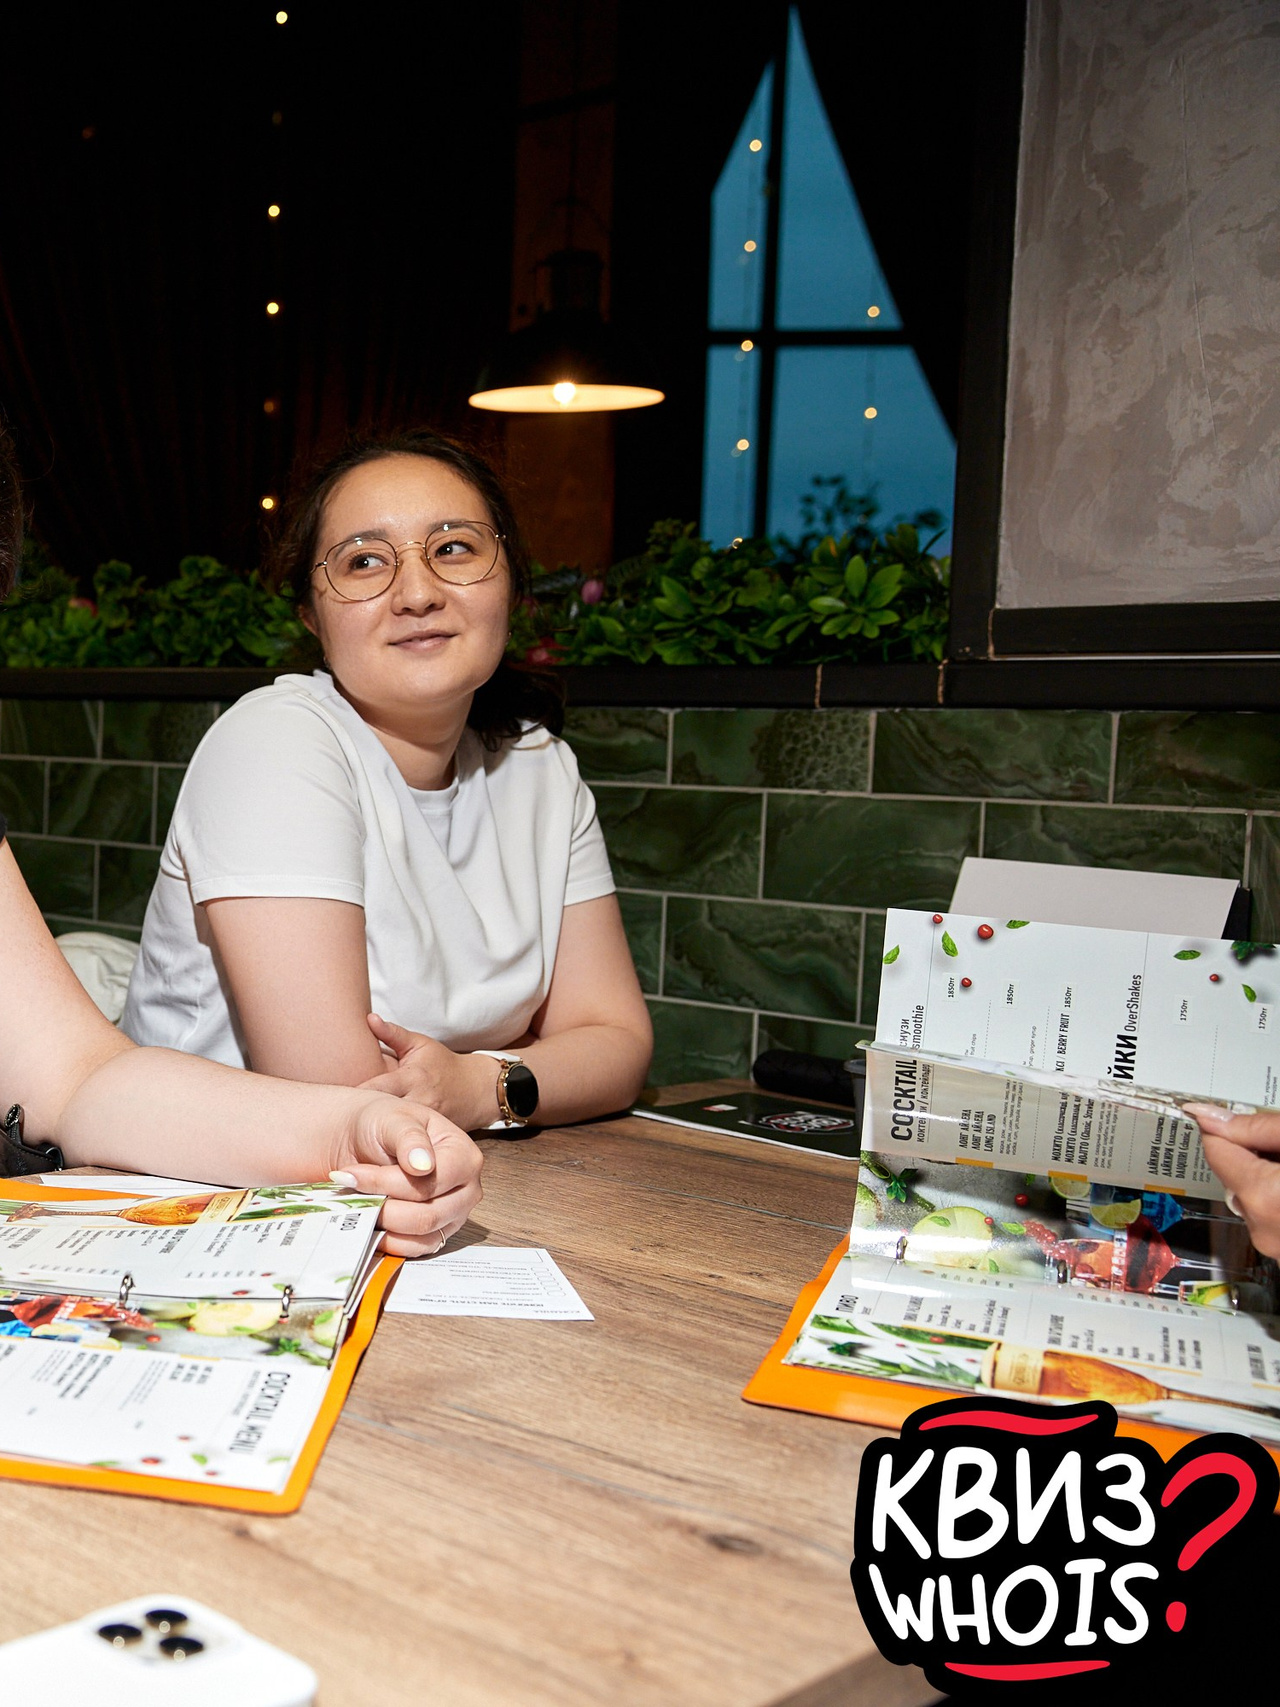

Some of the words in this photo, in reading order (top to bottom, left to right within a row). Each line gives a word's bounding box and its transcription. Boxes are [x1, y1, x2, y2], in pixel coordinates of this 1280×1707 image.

[900, 1018, 911, 1047] смузи
[911, 1004, 924, 1050] smoothie
[1059, 1013, 1070, 1033] FRUIT
[1107, 1033, 1139, 1083] ЙКИ
[1124, 974, 1142, 1032] OverShakes
[1057, 1033, 1068, 1055] BERRY
[890, 1060, 917, 1141] COCKTAIL
[986, 1114, 996, 1135] ISLAND
[984, 1136, 994, 1152] LONG
[1051, 1135, 1063, 1162] МОХИТО
[1065, 1137, 1076, 1163] МОХИТО
[1078, 1141, 1090, 1165] MOJITO
[1147, 1146, 1161, 1175] ДАЙКИРИ
[1161, 1147, 1174, 1177] ДАЙКИРИ
[340, 1213, 362, 1231] ПИВО
[835, 1294, 859, 1313] ПИВО
[246, 1371, 291, 1421] COCKTAIL
[229, 1425, 266, 1455] MENU
